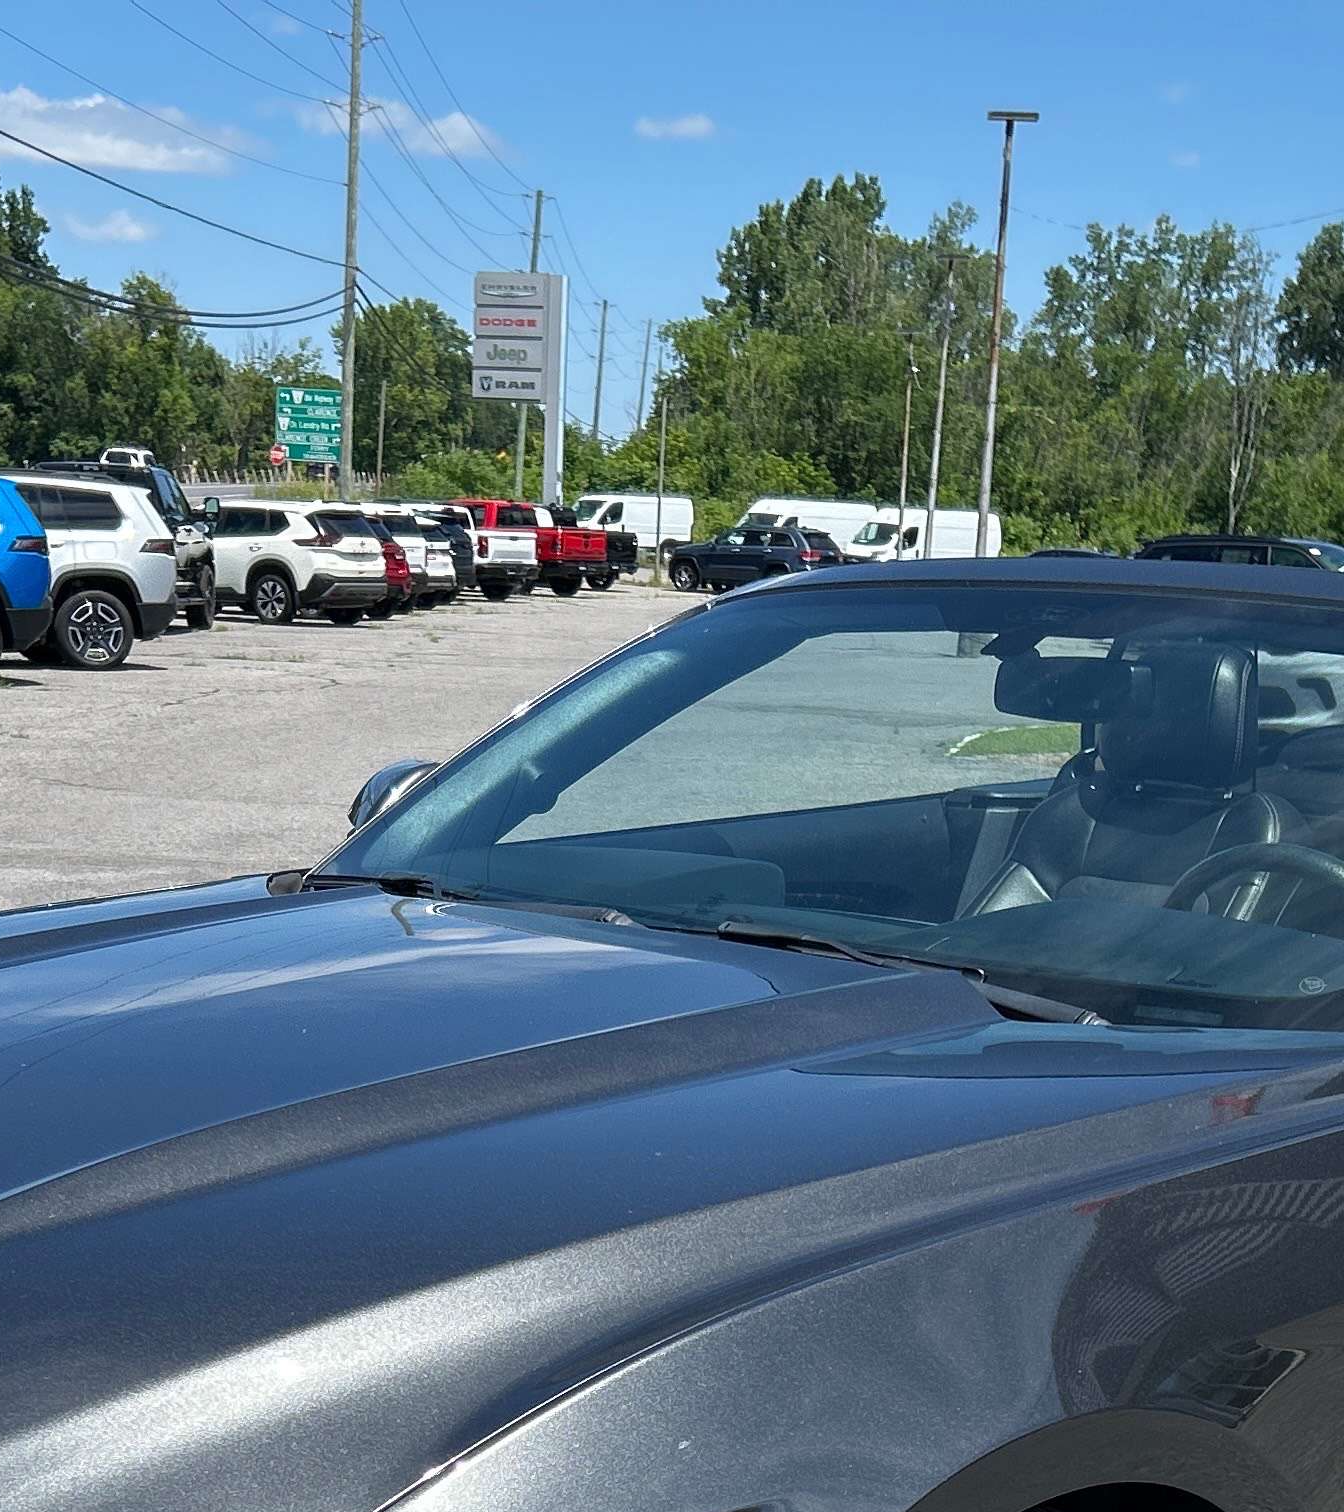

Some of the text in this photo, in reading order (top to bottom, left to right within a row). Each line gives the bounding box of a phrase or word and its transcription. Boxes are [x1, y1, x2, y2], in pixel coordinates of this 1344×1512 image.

[479, 317, 537, 328] DODGE
[486, 343, 527, 365] Jeep
[495, 380, 536, 390] RAM
